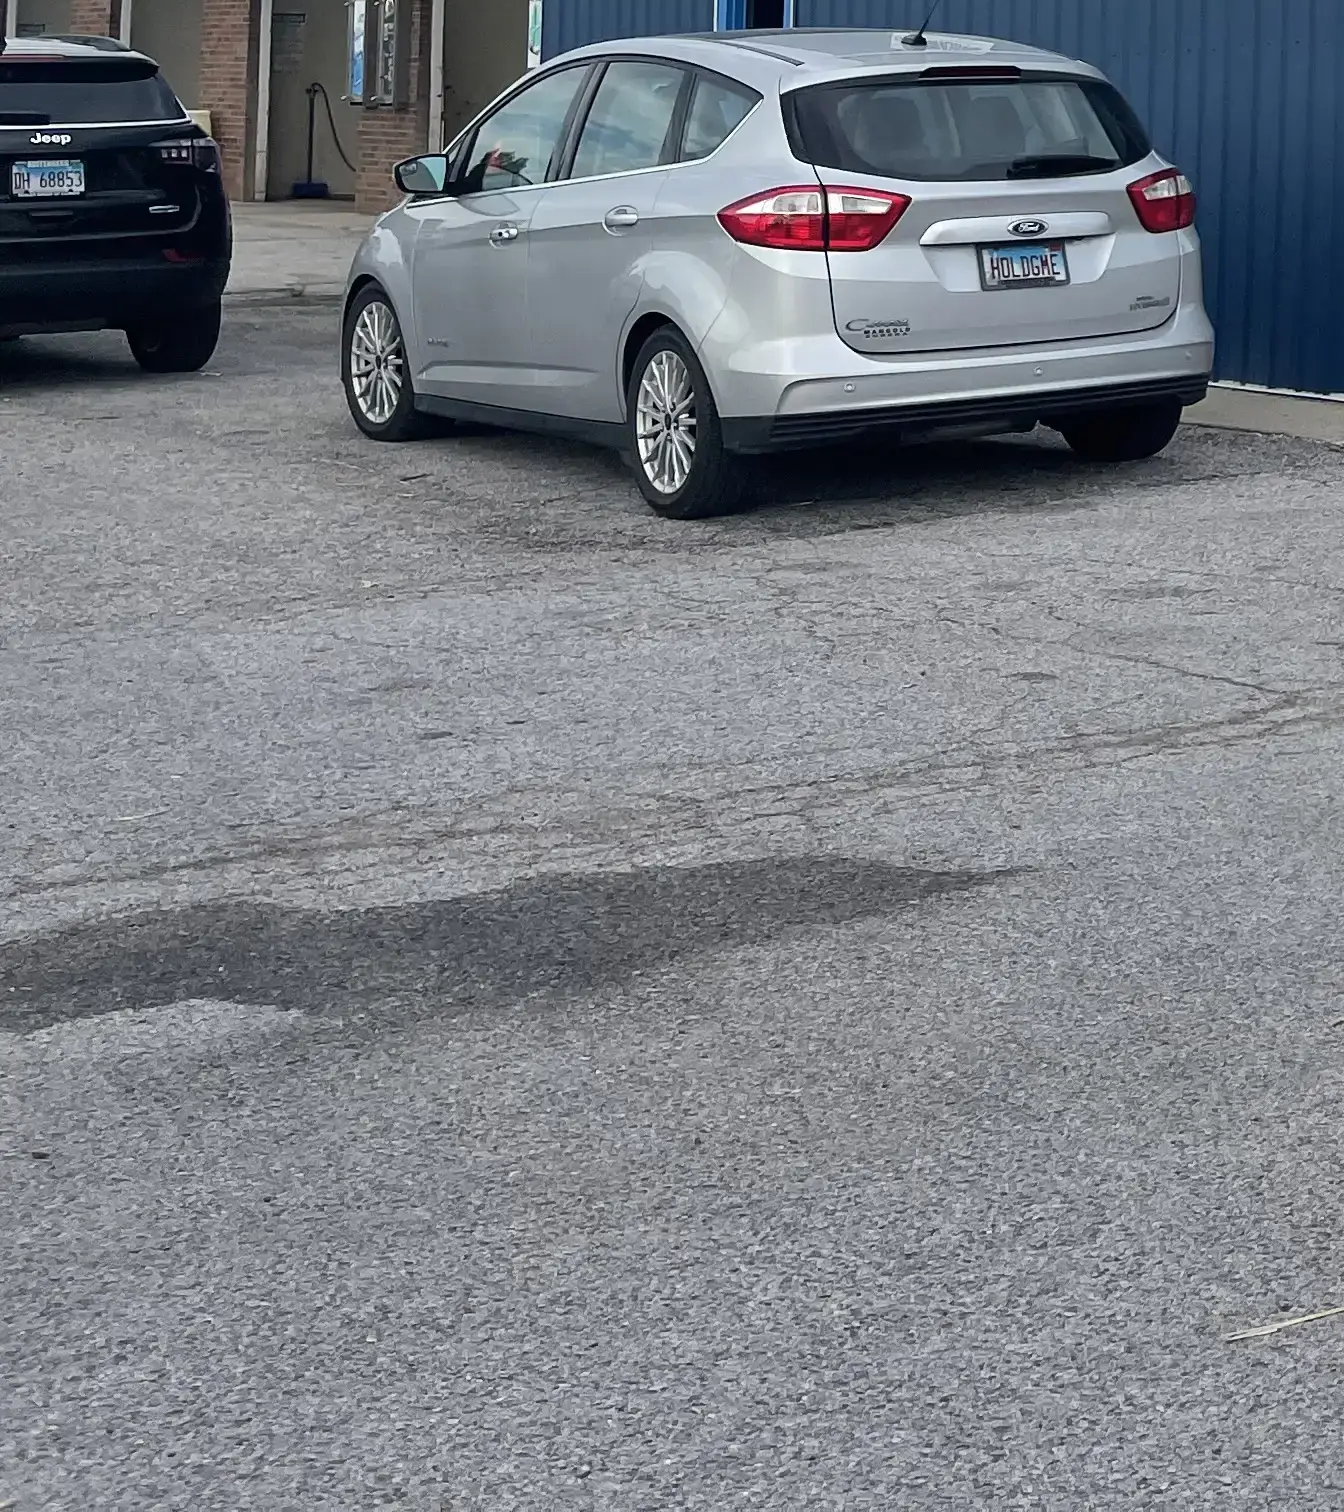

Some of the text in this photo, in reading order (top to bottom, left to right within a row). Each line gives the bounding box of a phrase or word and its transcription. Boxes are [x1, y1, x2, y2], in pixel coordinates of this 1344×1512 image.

[30, 132, 72, 145] Jeep
[40, 170, 82, 188] 68853
[1018, 221, 1041, 233] Ford
